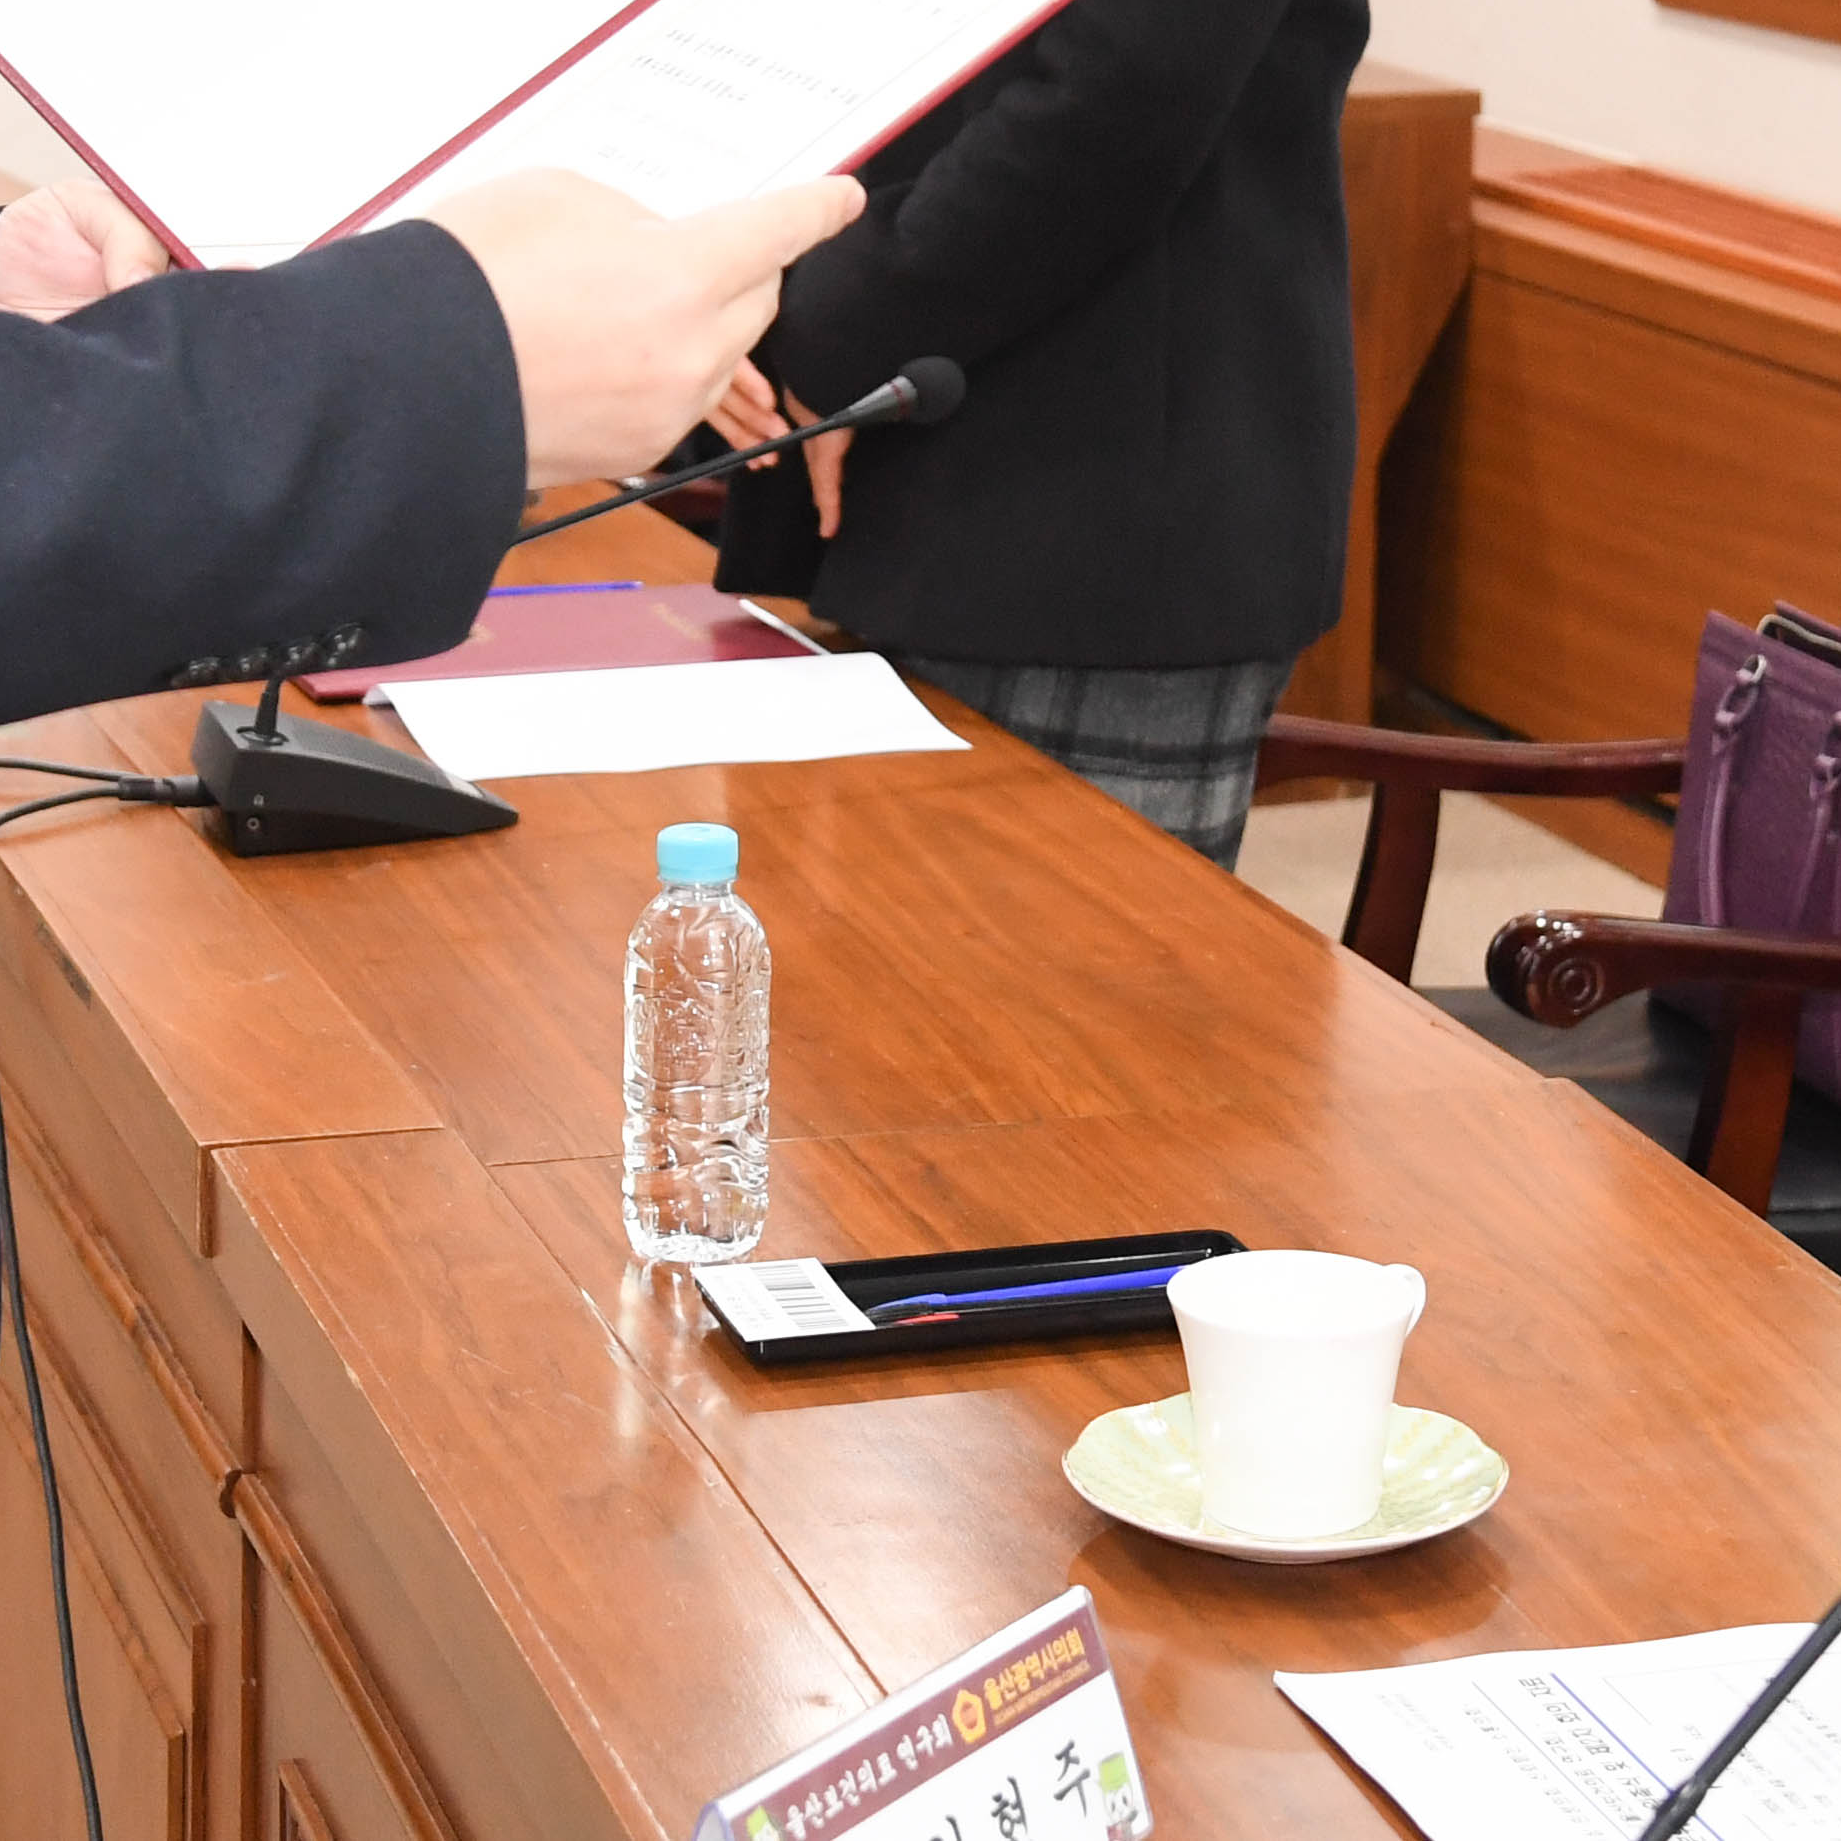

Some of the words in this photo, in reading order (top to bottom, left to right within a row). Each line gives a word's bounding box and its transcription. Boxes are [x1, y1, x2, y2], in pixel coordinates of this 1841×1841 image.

[982, 1628, 1087, 1712] 울산광역시의회
[785, 1751, 898, 1841] 울산보건의료
[896, 1711, 955, 1770] 연구회
